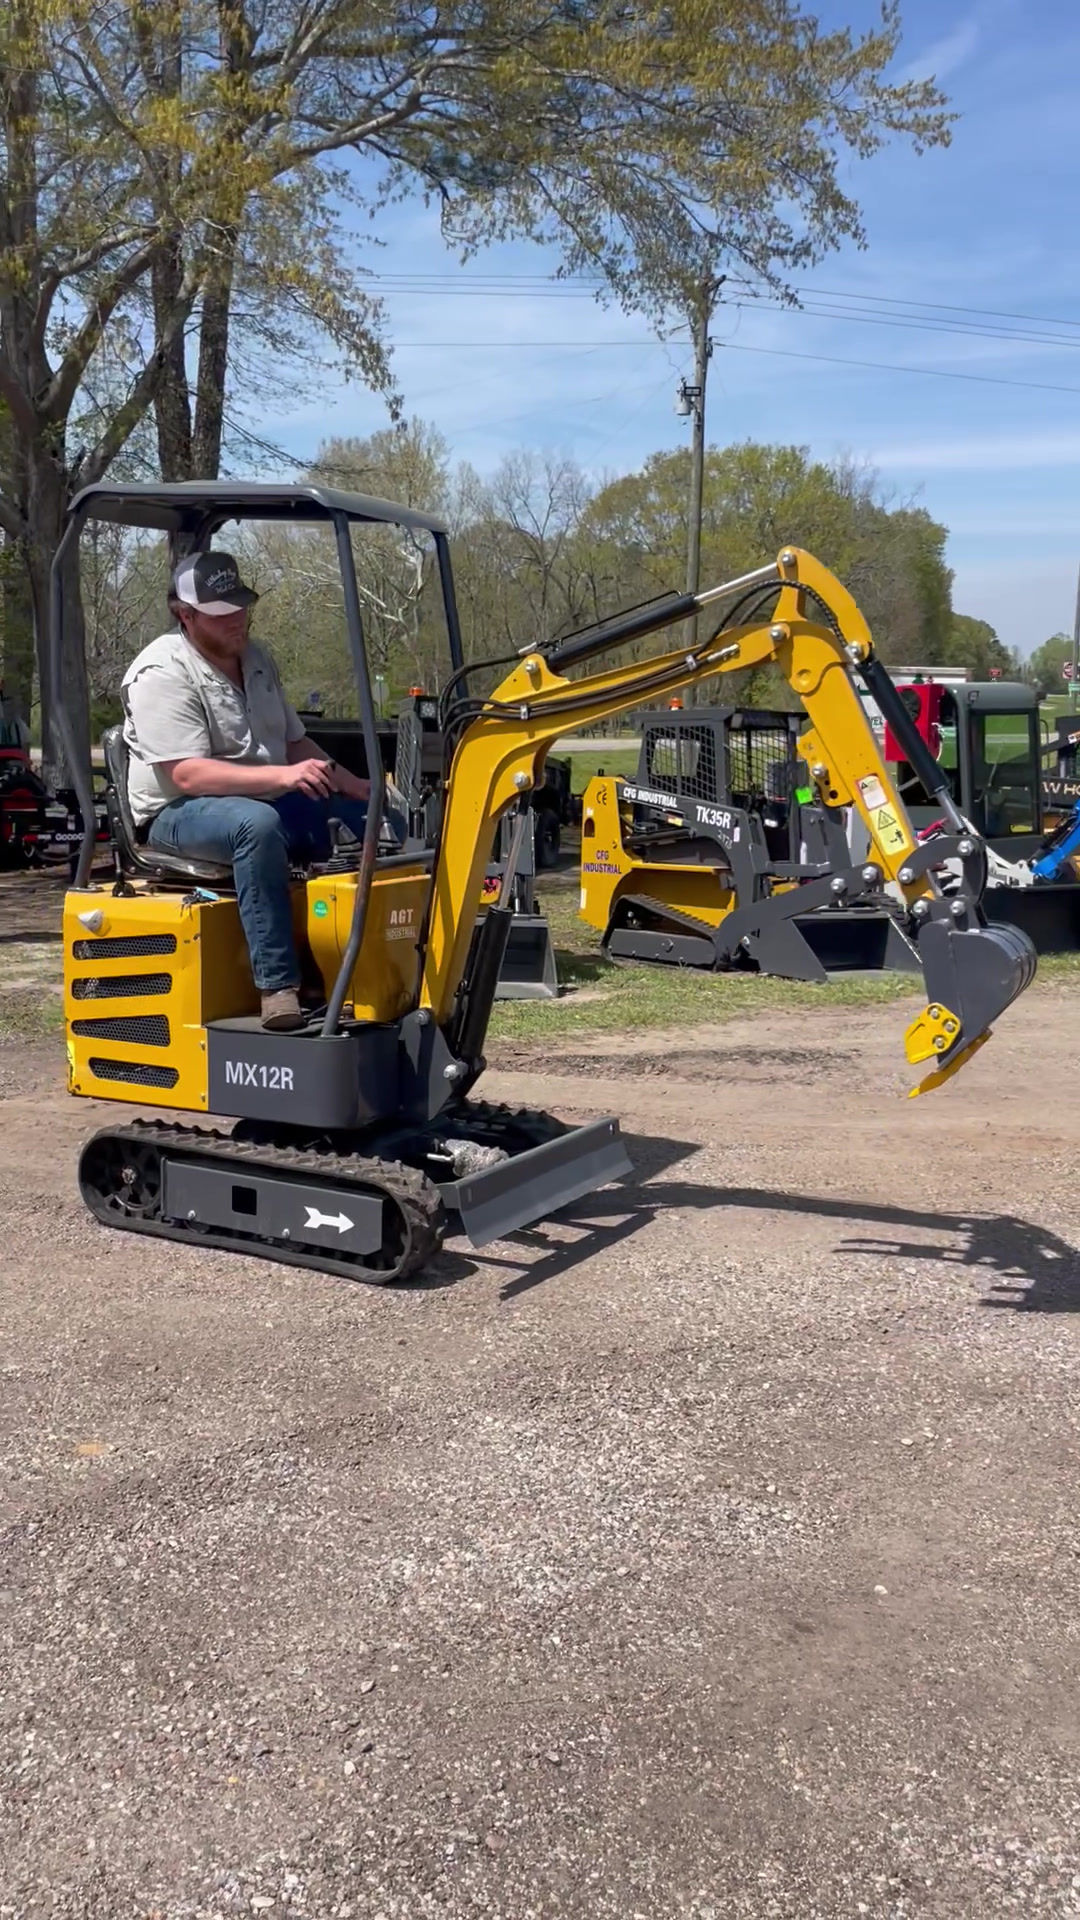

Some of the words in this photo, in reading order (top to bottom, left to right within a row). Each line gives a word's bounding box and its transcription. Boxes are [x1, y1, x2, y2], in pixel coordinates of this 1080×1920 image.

[623, 787, 636, 799] CFG
[637, 789, 678, 808] INDUSTRIAL
[695, 805, 731, 829] TK35R
[596, 850, 609, 860] CFG
[583, 863, 621, 874] INDUSTRIAL
[390, 908, 414, 925] AGT
[225, 1060, 294, 1091] MX12R
